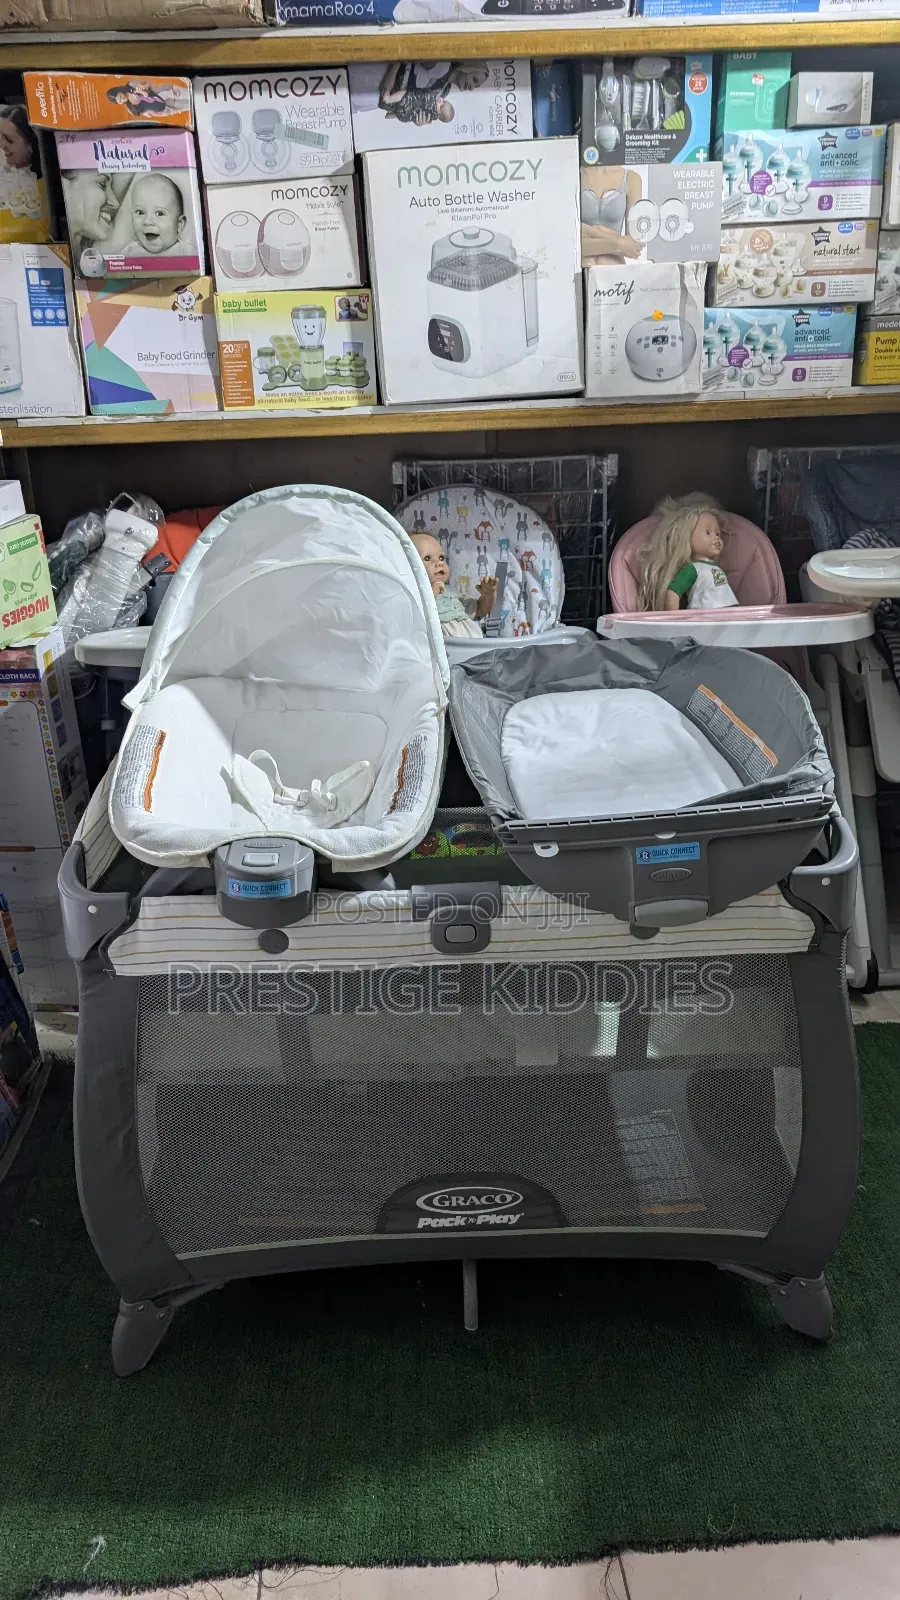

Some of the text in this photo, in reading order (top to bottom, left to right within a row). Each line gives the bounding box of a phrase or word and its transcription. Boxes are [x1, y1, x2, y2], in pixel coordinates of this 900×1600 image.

[493, 68, 504, 136] BABY CARRIER
[285, 102, 345, 118] Wearable
[318, 118, 347, 130] Pump
[92, 140, 149, 160] Natural
[820, 151, 858, 160] advanced
[673, 170, 714, 179] WEARABLE
[678, 181, 714, 189] ELECTRIC
[409, 189, 536, 208] Auto Bottle Washer
[684, 191, 714, 199] BREAST
[691, 202, 714, 210] PUMP
[813, 244, 860, 256] natural start
[594, 280, 634, 305] motif
[222, 299, 267, 310] baby bullet
[188, 314, 204, 322] Gym
[876, 336, 897, 346] Pump
[223, 344, 234, 353] 20
[138, 350, 215, 363] Baby Food Grinder
[2, 595, 50, 628] HUGGIES
[652, 847, 695, 857] QUICK CONNECT
[432, 1194, 513, 1207] GRACO
[417, 1216, 467, 1228] Pack
[476, 1214, 520, 1225] Play
